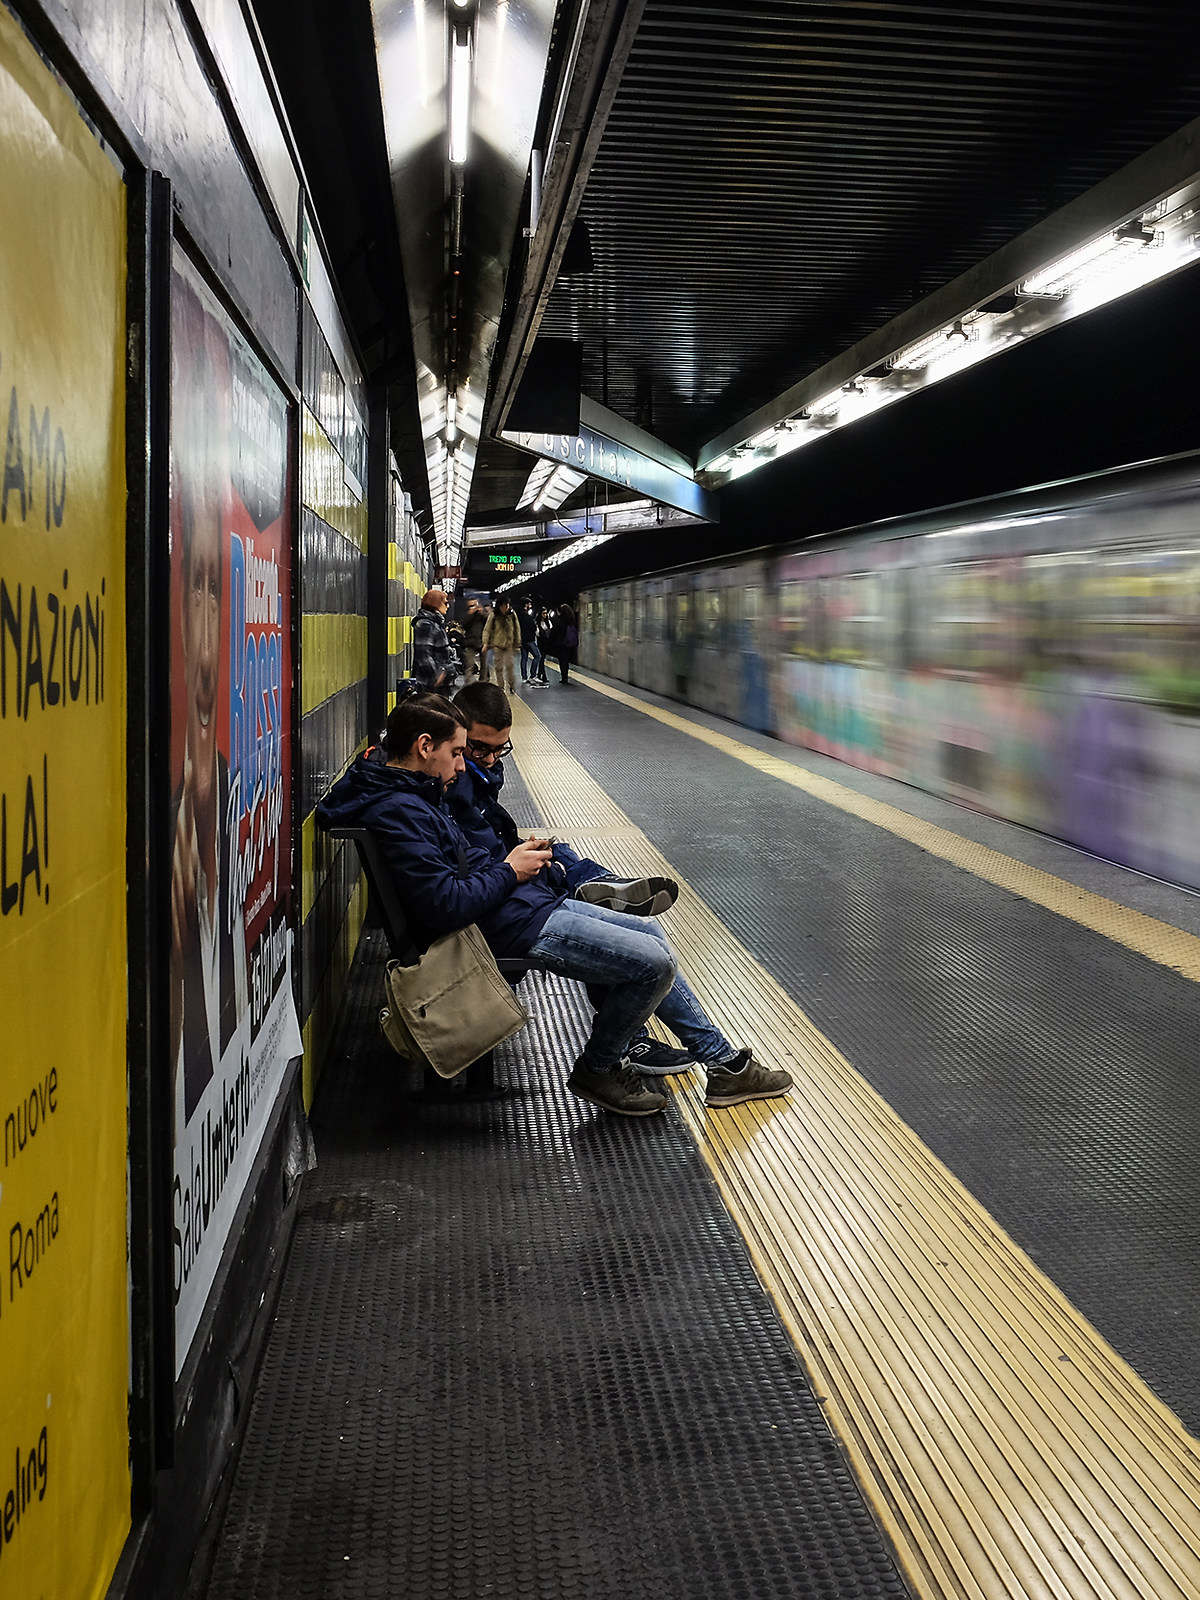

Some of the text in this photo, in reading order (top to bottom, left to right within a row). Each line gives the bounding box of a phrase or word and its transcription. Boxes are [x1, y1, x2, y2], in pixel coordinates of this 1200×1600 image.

[543, 433, 618, 476] uscita
[245, 536, 279, 624] Riccardo
[510, 556, 521, 564] PER
[229, 531, 282, 822] Rossi
[1, 753, 49, 916] LA!
[4, 1066, 58, 1167] nuove
[9, 1191, 59, 1303] Roma
